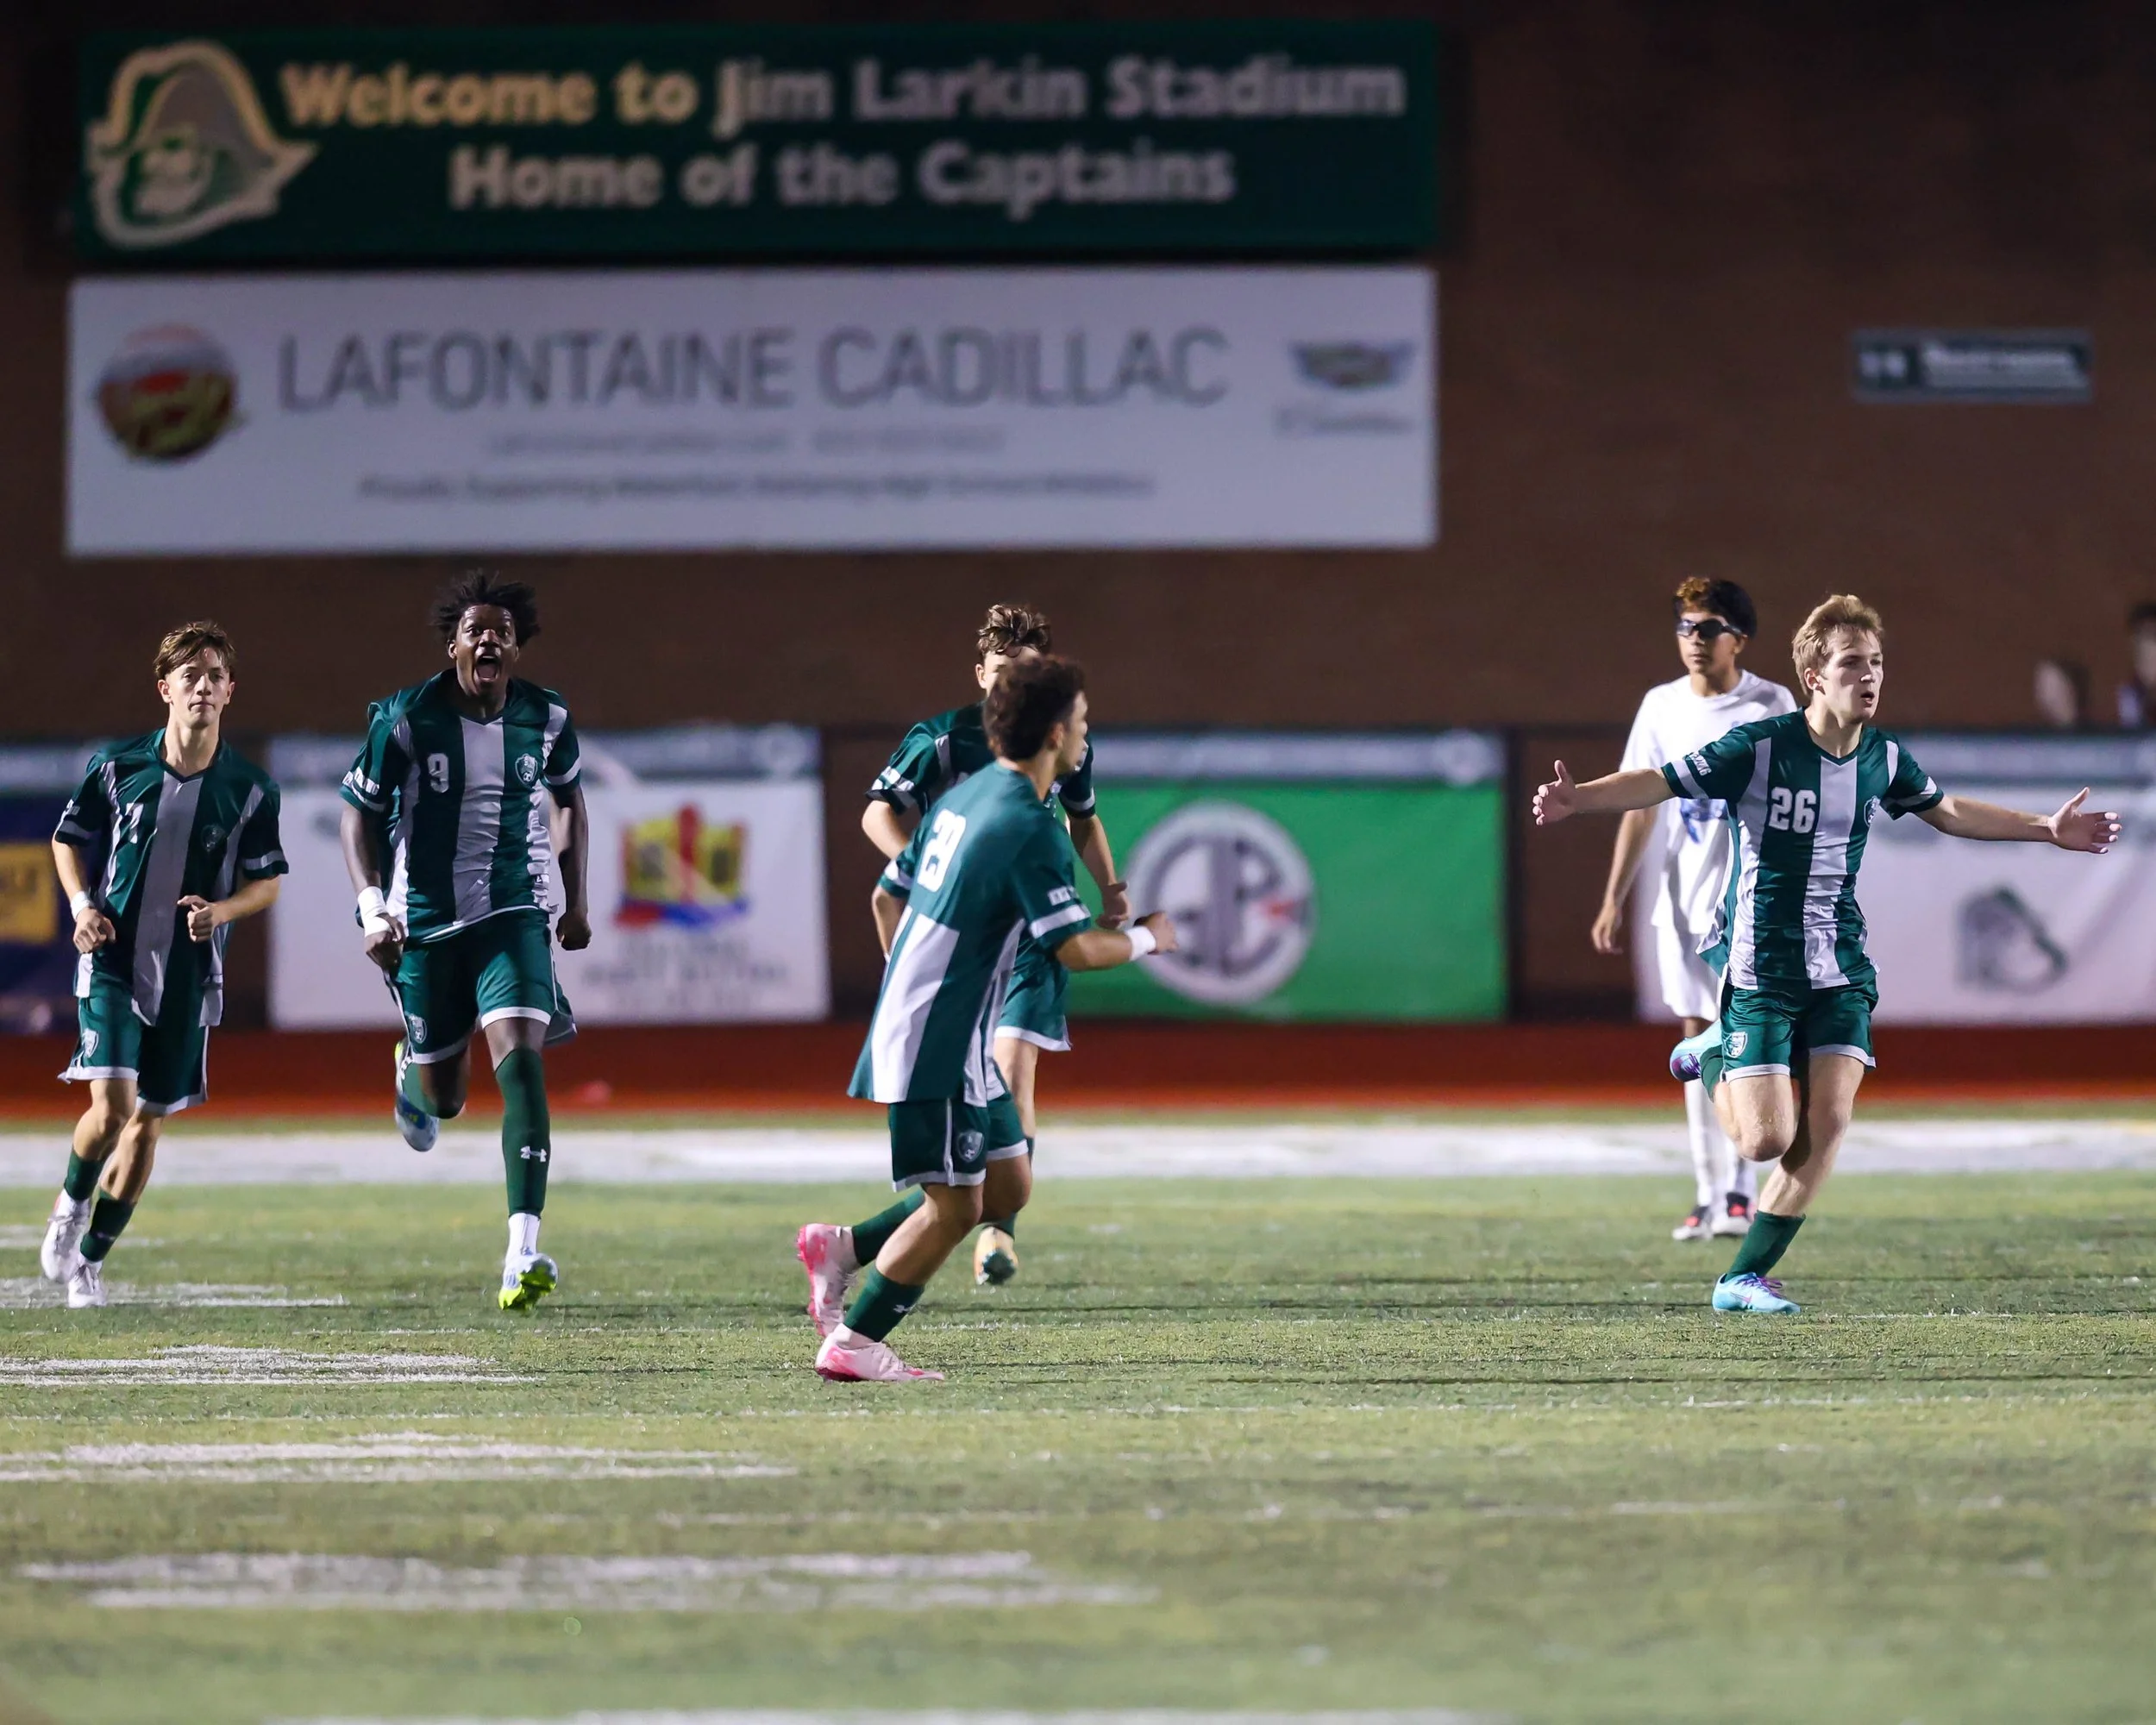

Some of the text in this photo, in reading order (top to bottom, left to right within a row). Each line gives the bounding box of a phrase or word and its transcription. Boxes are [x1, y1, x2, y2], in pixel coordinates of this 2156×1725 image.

[281, 53, 1406, 137] Welcome to Jim Larkin Stadium
[452, 140, 1235, 220] Home of the Captains
[279, 325, 1227, 411] LAFONTAINE CADILLAC
[427, 753, 449, 794] 9
[1769, 786, 1817, 834] 26
